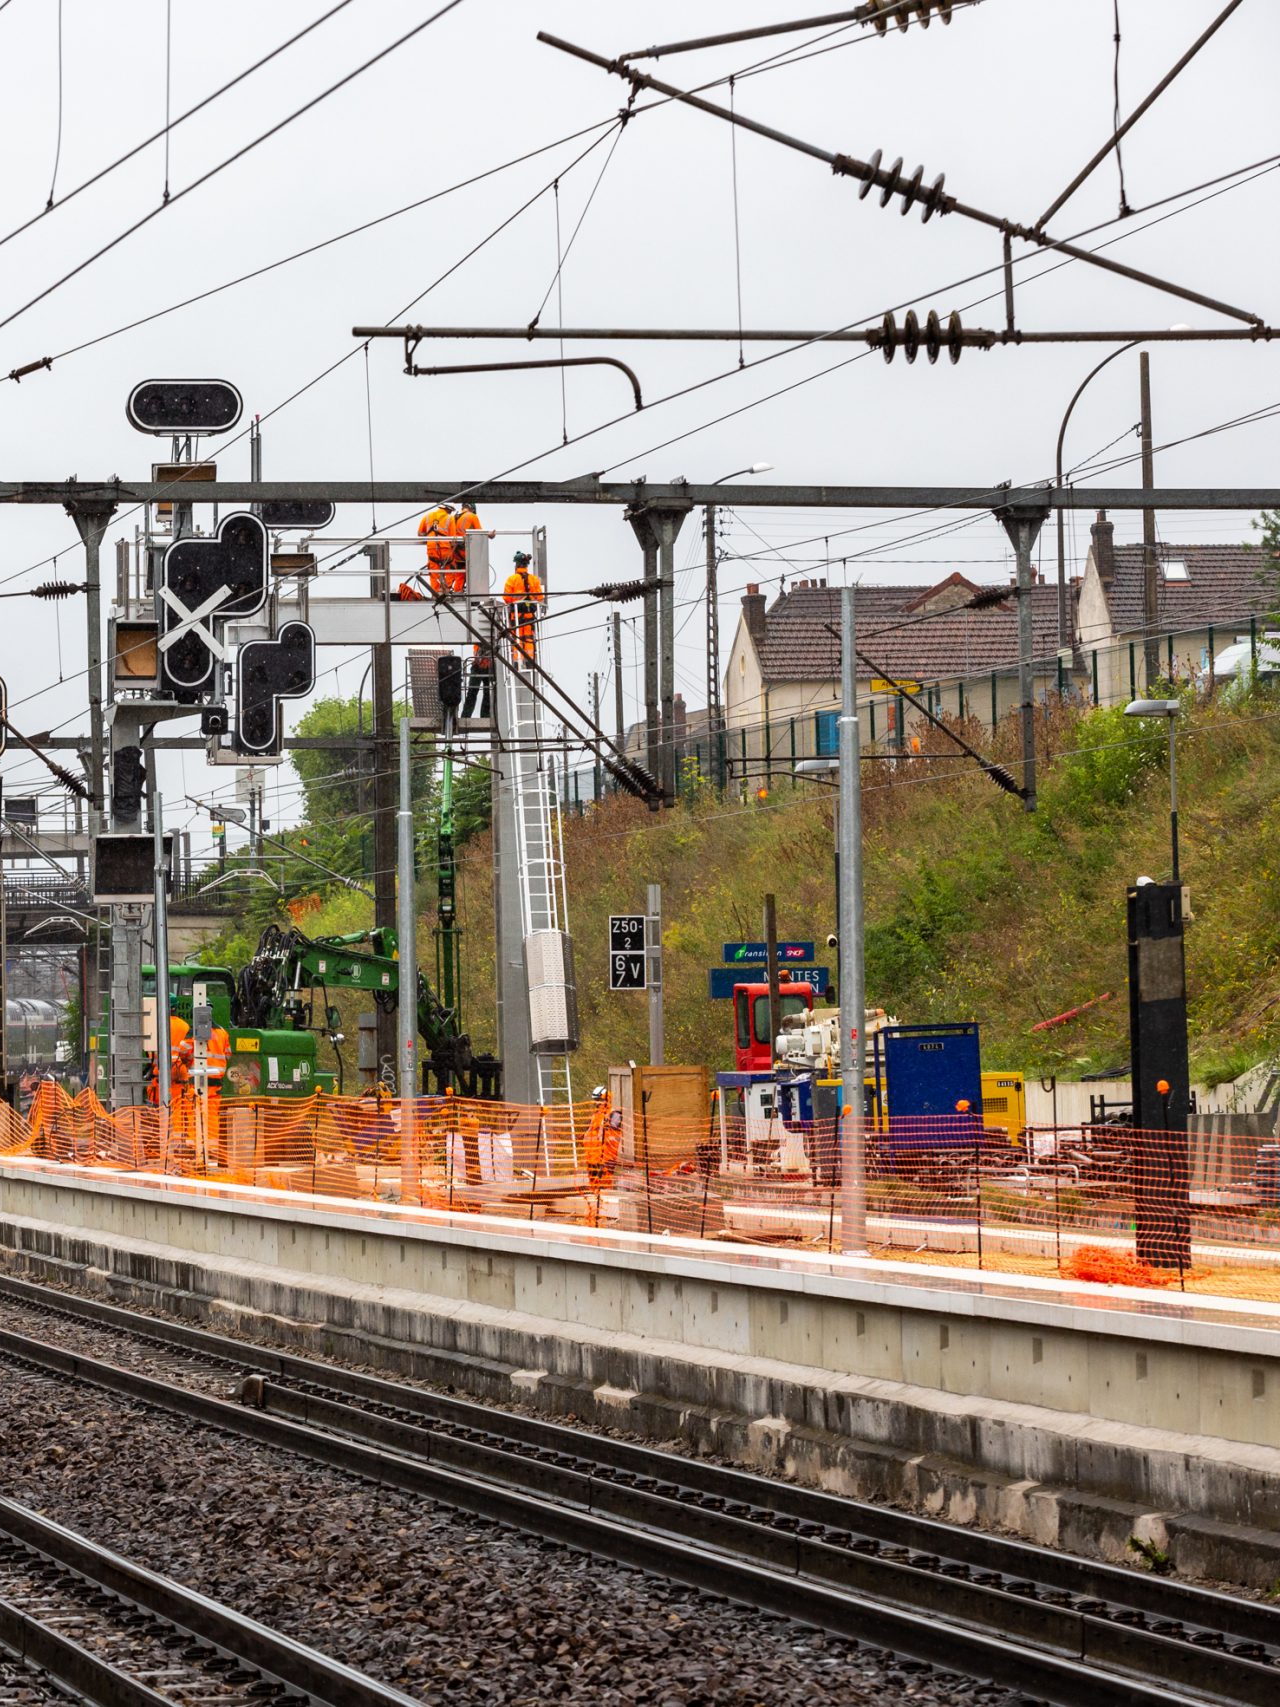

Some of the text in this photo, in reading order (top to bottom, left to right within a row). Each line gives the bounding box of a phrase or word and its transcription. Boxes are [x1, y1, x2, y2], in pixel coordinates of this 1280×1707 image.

[612, 920, 642, 933] Z50-
[624, 937, 631, 948] 2
[616, 955, 625, 970] 6
[631, 963, 640, 979] V
[616, 971, 626, 986] 7
[230, 1070, 239, 1078] 25
